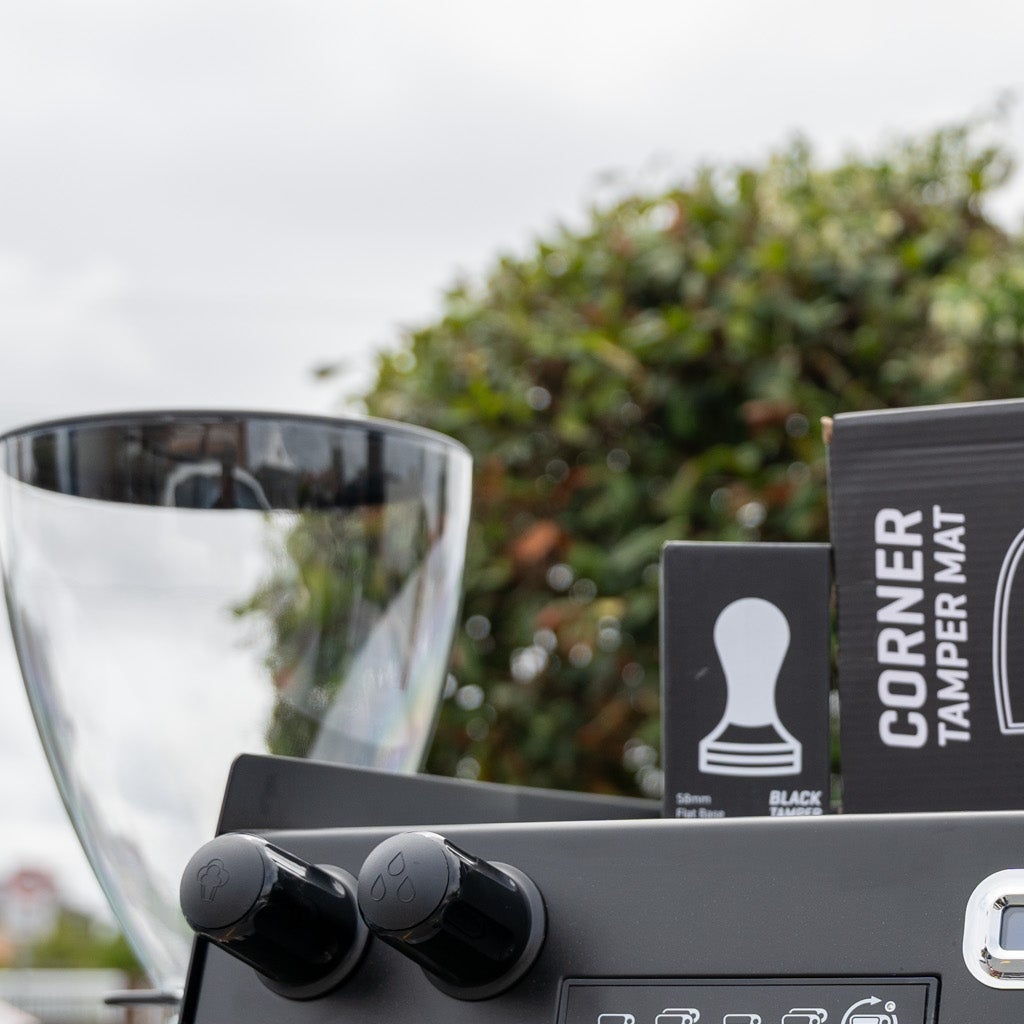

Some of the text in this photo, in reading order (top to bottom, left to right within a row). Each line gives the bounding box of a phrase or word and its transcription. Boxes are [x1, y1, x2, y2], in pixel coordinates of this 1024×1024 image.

[875, 508, 928, 748] CORNER
[932, 505, 971, 747] TAMPER MAT
[675, 792, 712, 805] 58mm
[769, 790, 822, 806] BLACK
[675, 807, 697, 818] Flat
